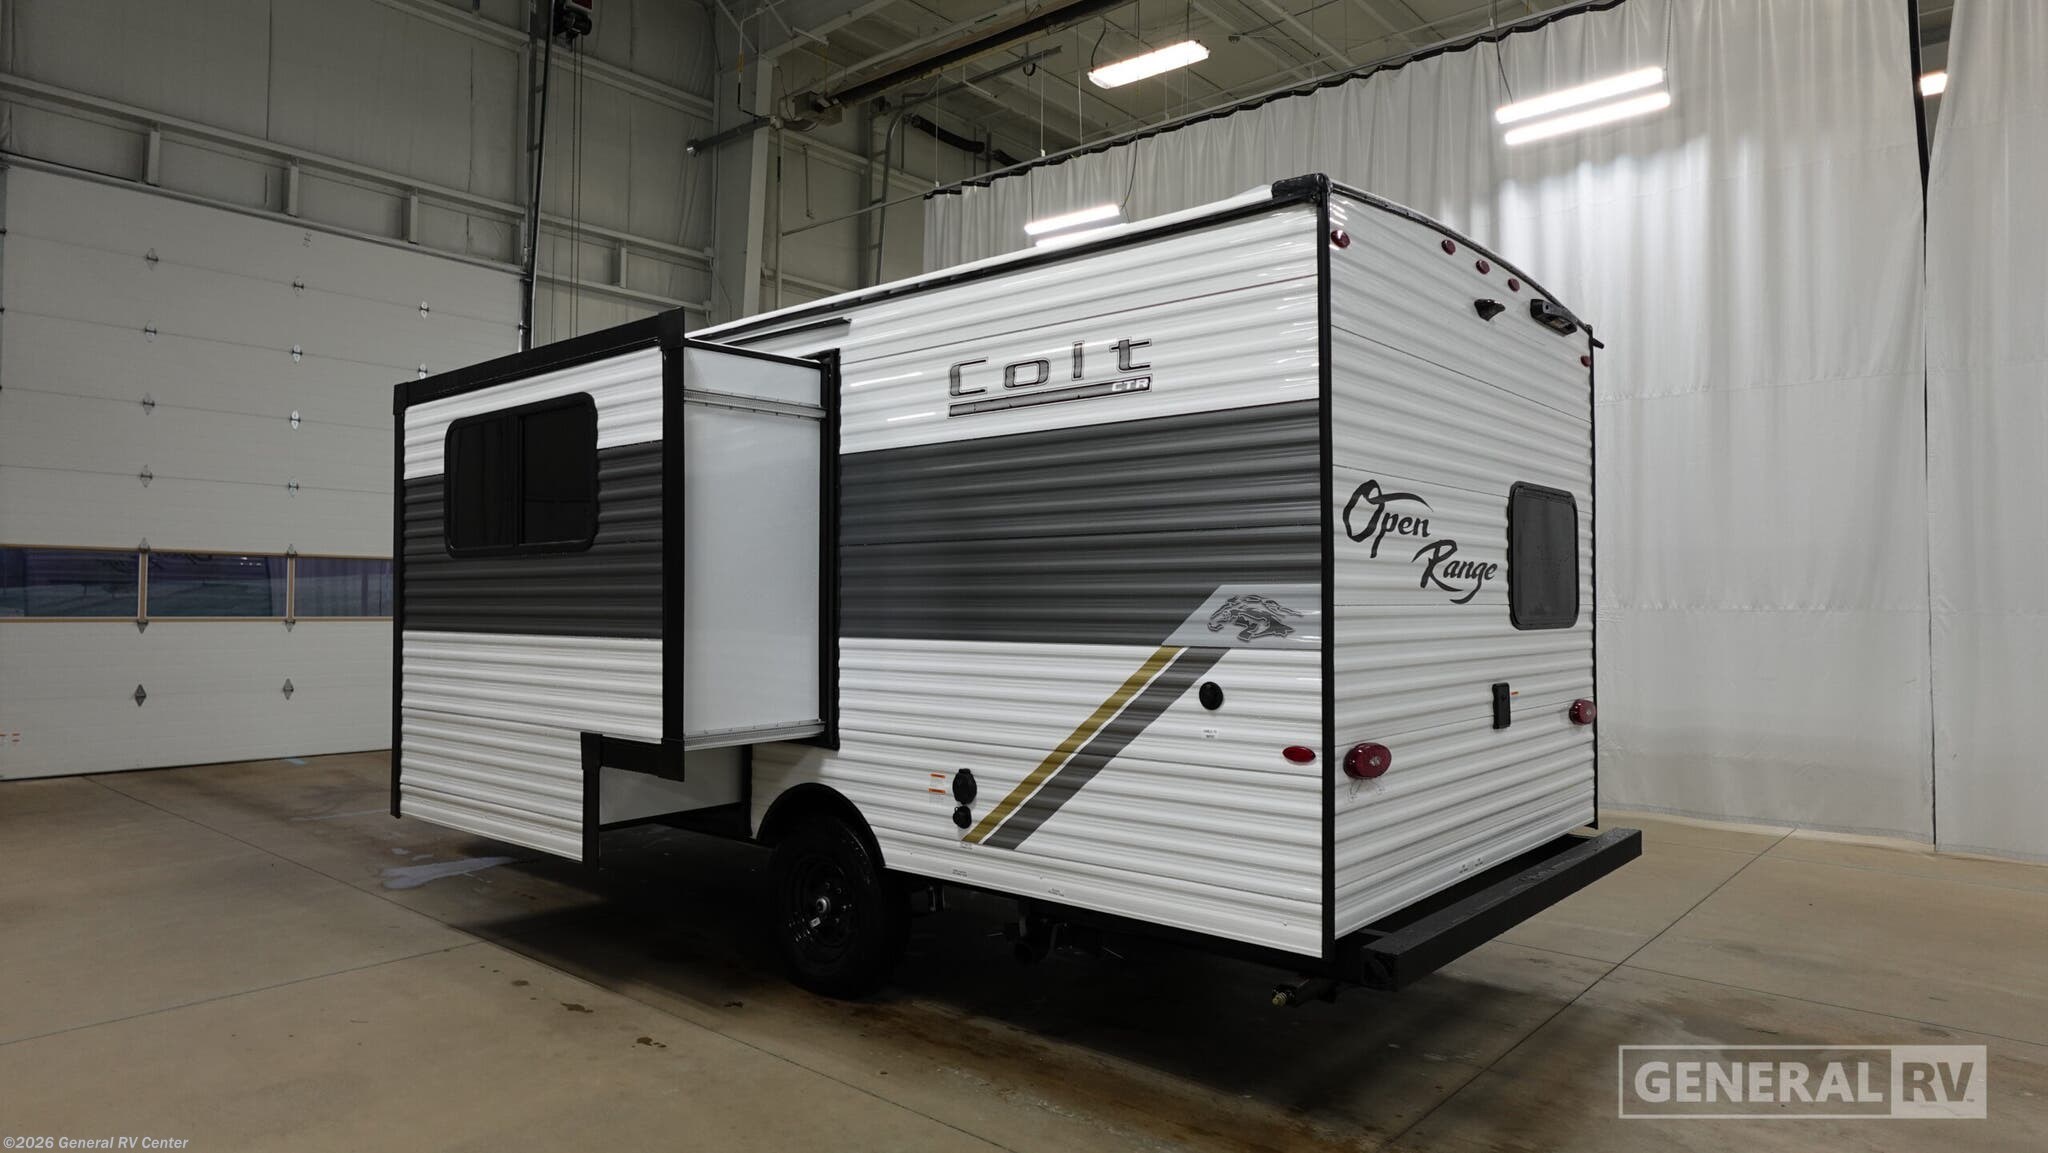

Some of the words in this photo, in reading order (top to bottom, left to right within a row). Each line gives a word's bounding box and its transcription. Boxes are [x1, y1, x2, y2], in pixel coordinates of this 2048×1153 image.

[1111, 378, 1149, 392] CTR
[1342, 479, 1433, 558] Open
[1411, 539, 1498, 605] Range
